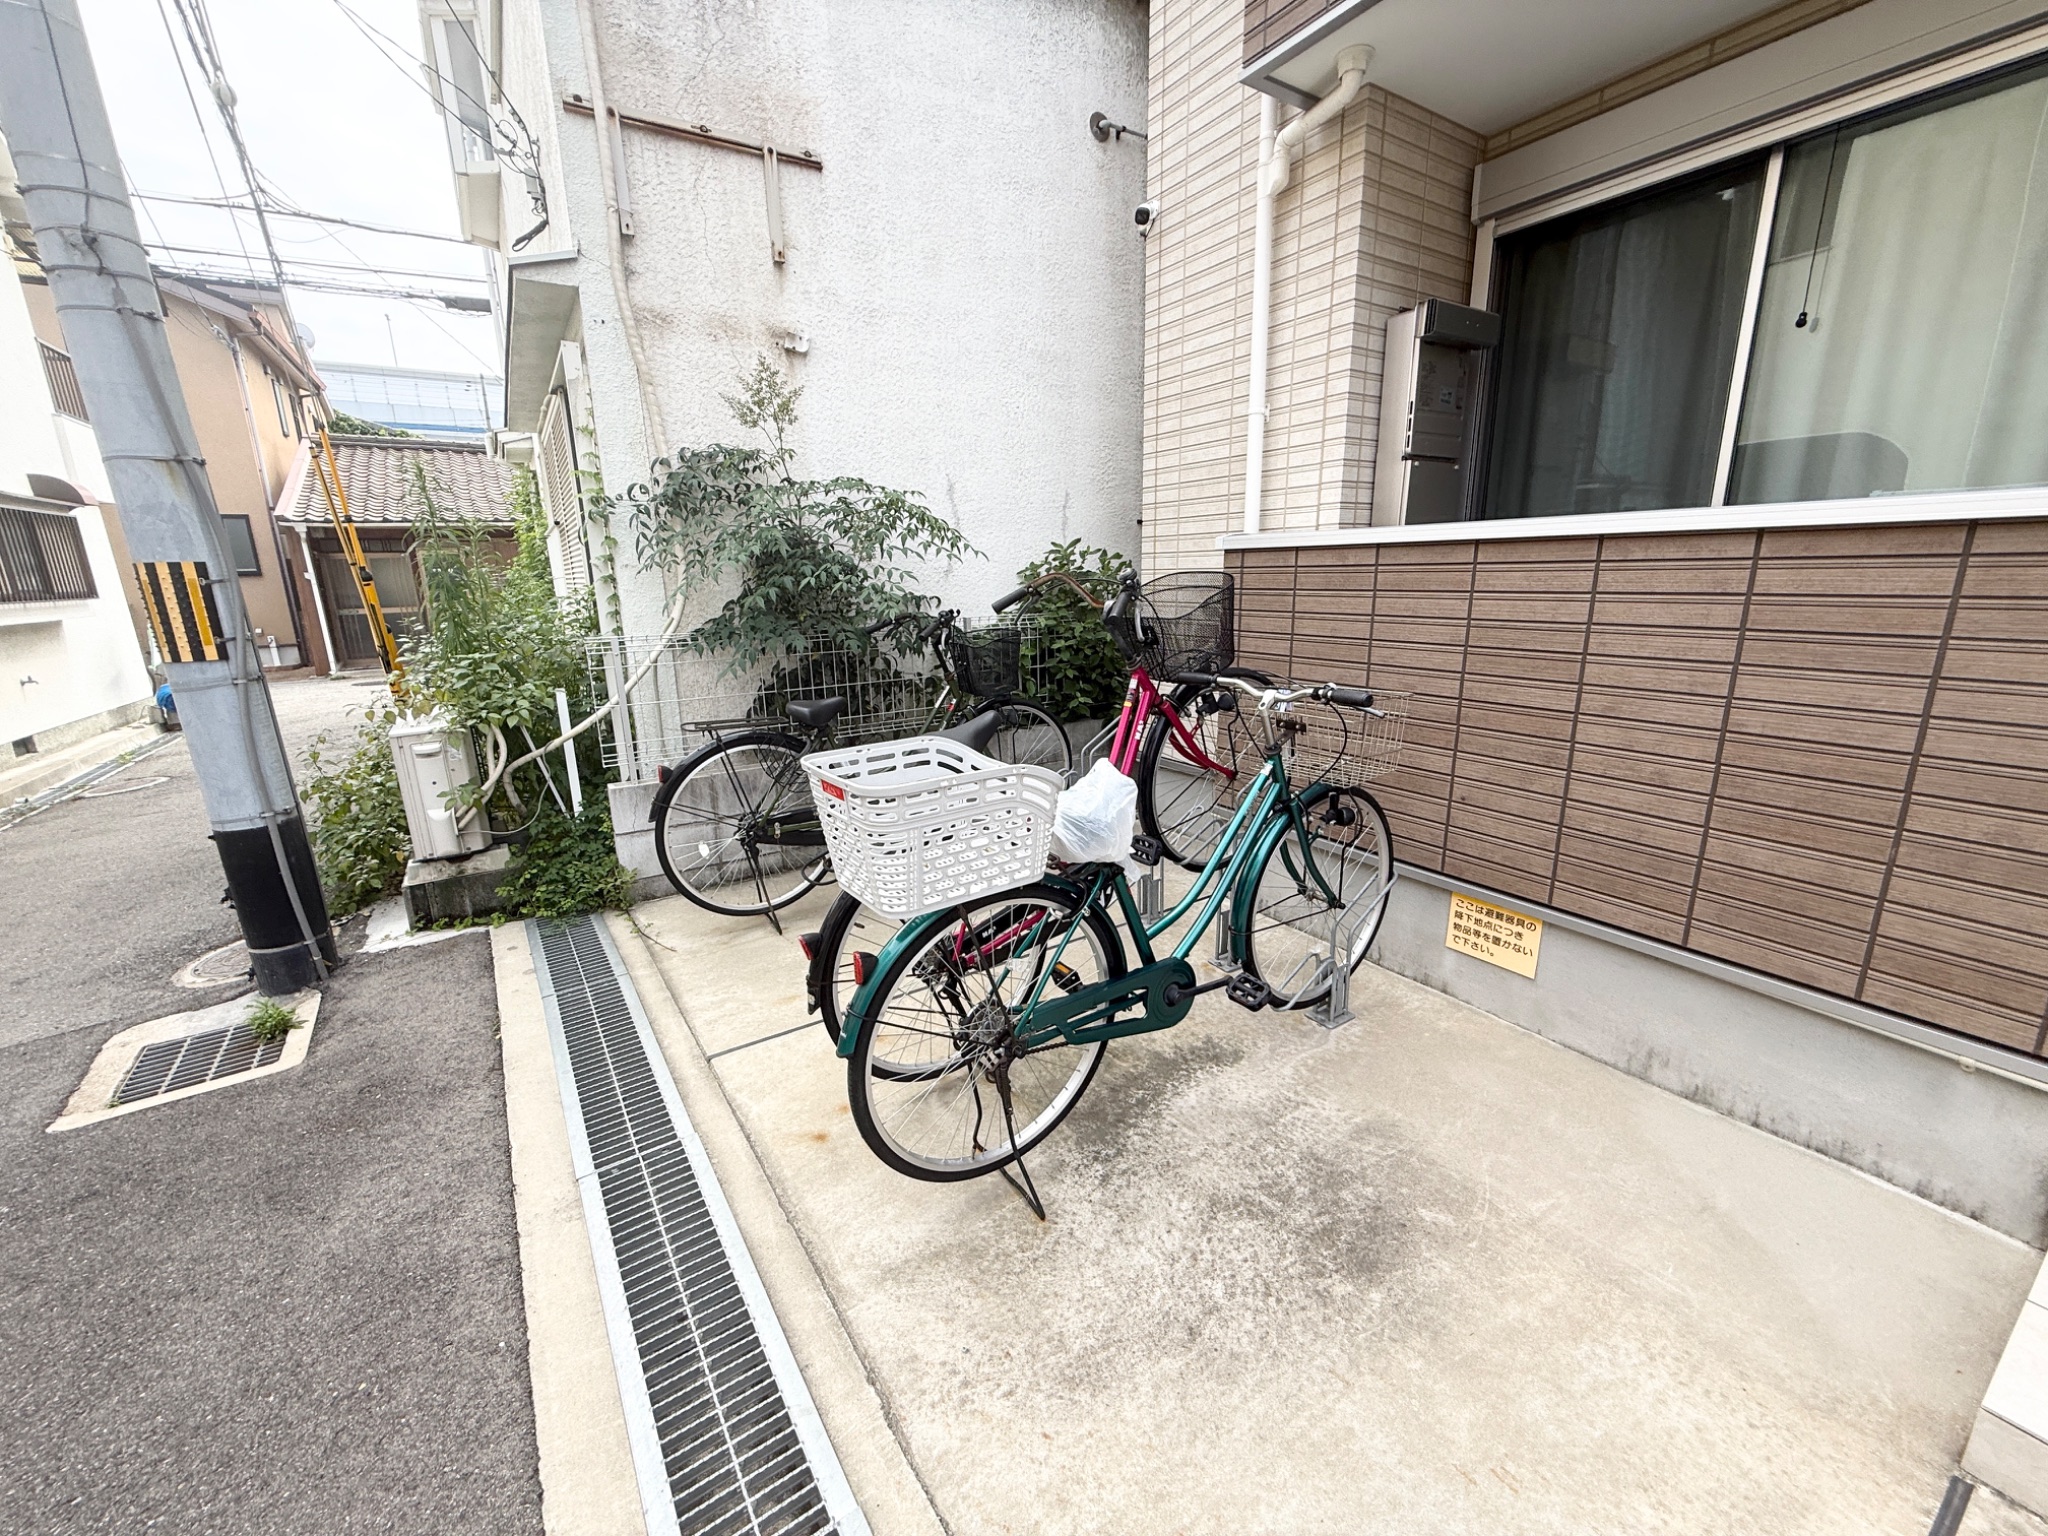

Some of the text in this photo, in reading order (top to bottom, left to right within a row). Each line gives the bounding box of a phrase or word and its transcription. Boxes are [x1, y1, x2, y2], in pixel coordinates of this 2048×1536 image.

[1454, 910, 1524, 941] 降下地点につき
[1456, 898, 1537, 932] ここは避難器具の
[1452, 934, 1494, 957] で下さい。
[1453, 922, 1533, 957] 物品等を置かない
